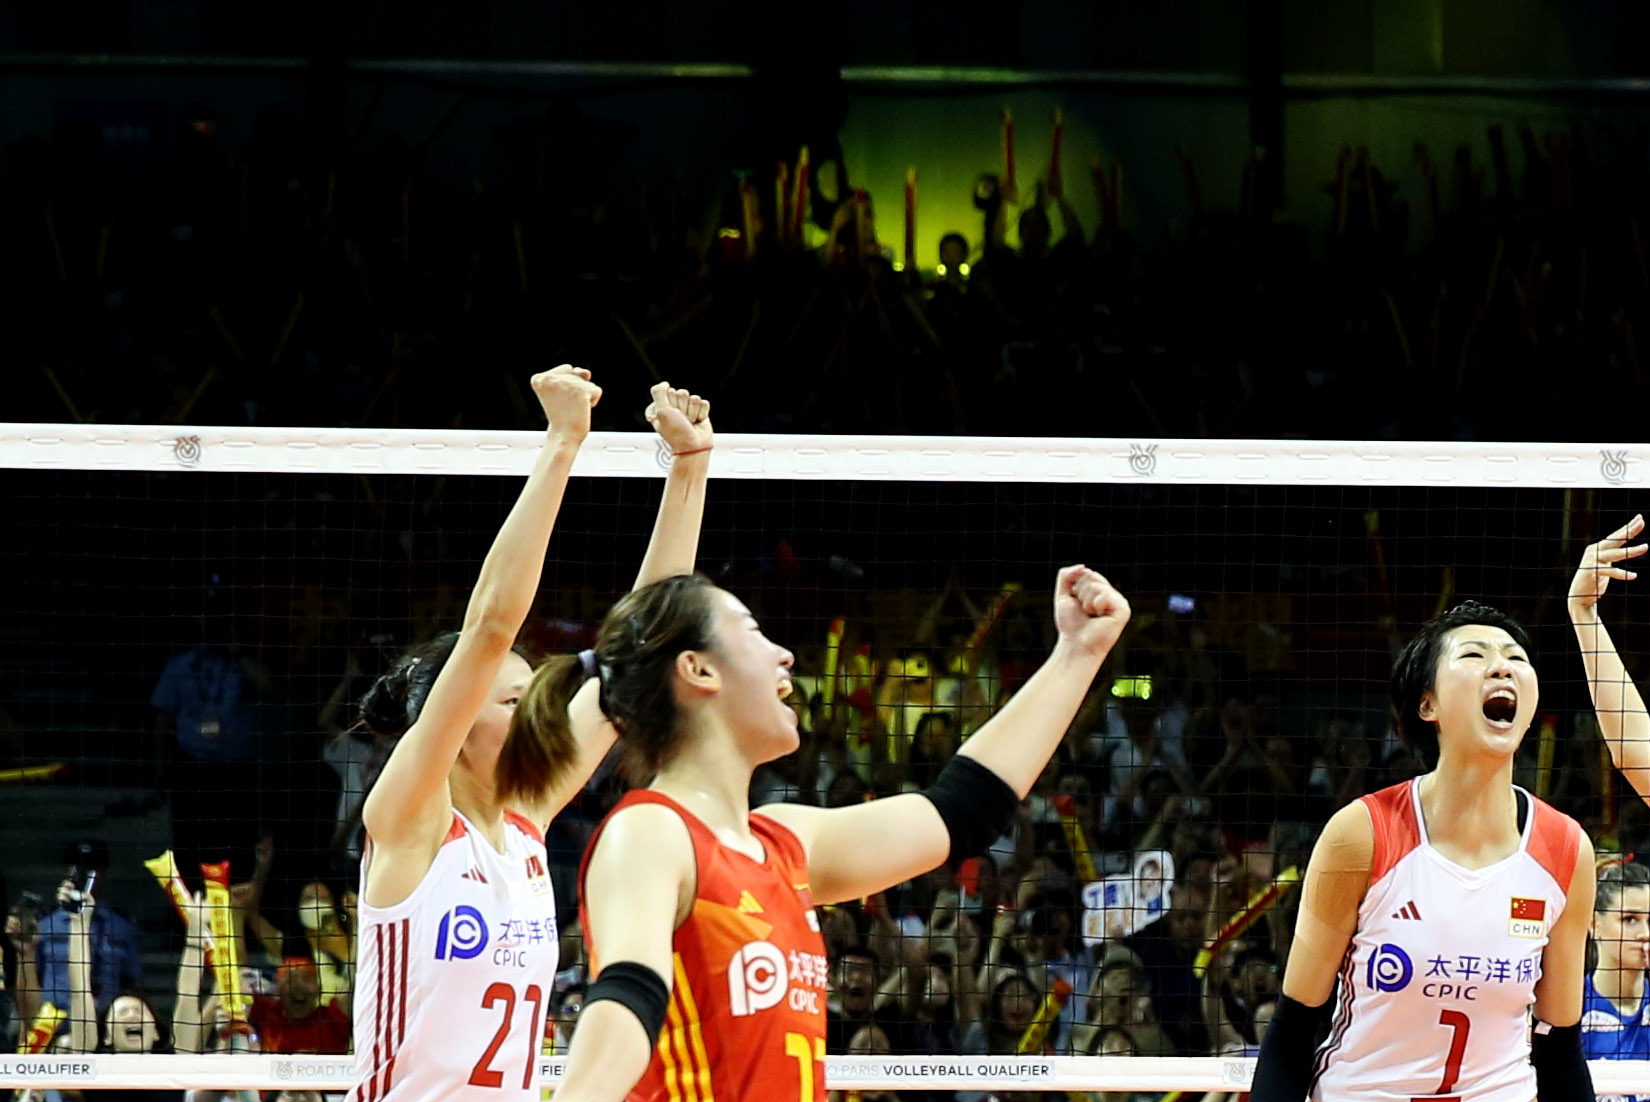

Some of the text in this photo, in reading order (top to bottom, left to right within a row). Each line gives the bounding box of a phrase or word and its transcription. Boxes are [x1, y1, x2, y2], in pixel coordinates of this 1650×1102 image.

[1512, 923, 1540, 934] CHN
[493, 948, 526, 968] CPIC
[1422, 983, 1478, 1000] CPIC
[788, 987, 820, 1015] CPIC
[467, 982, 542, 1090] 21
[16, 1063, 90, 1077] QUALIFIER
[296, 1064, 333, 1078] ROAD
[842, 1064, 879, 1076] PARIS
[882, 1064, 974, 1077] VOLLEYBALL
[977, 1064, 1049, 1077] QUALIFIER
